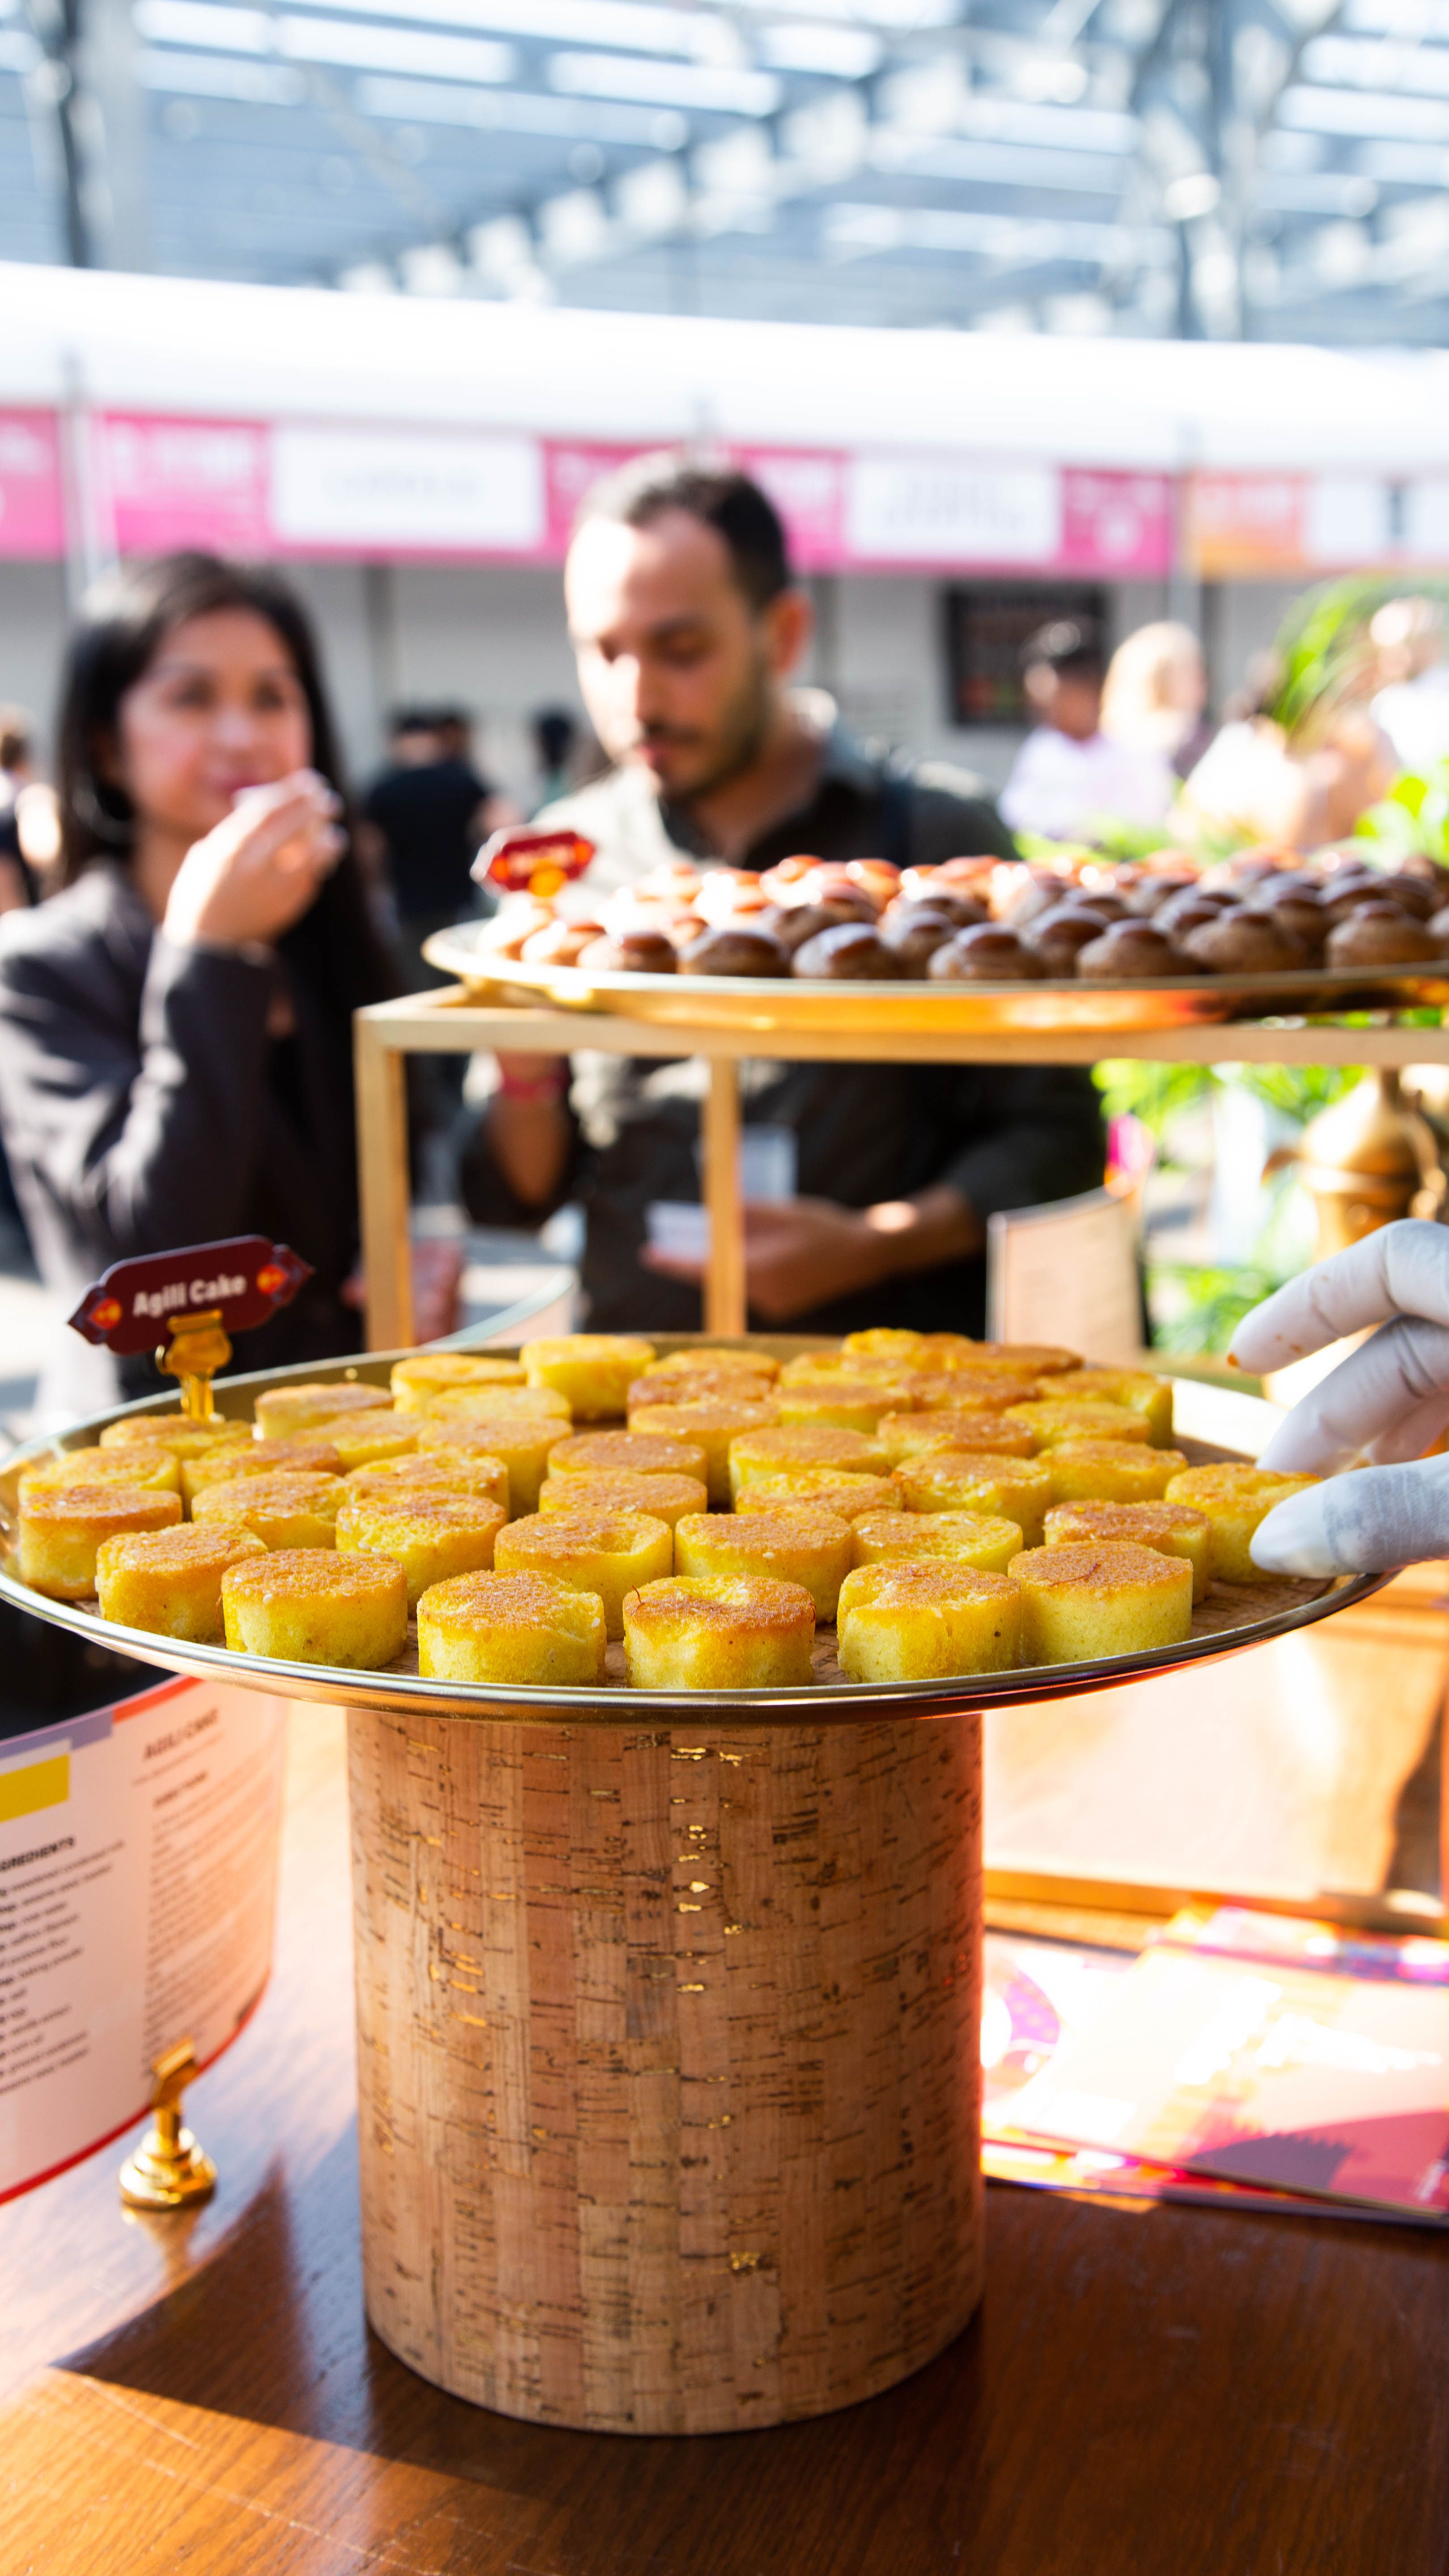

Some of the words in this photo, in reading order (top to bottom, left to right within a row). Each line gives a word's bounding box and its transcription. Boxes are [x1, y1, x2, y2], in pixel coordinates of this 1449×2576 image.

[132, 1282, 187, 1318] Agili
[189, 1273, 247, 1305] Cake
[0, 1836, 75, 1871] GREDIENTS
